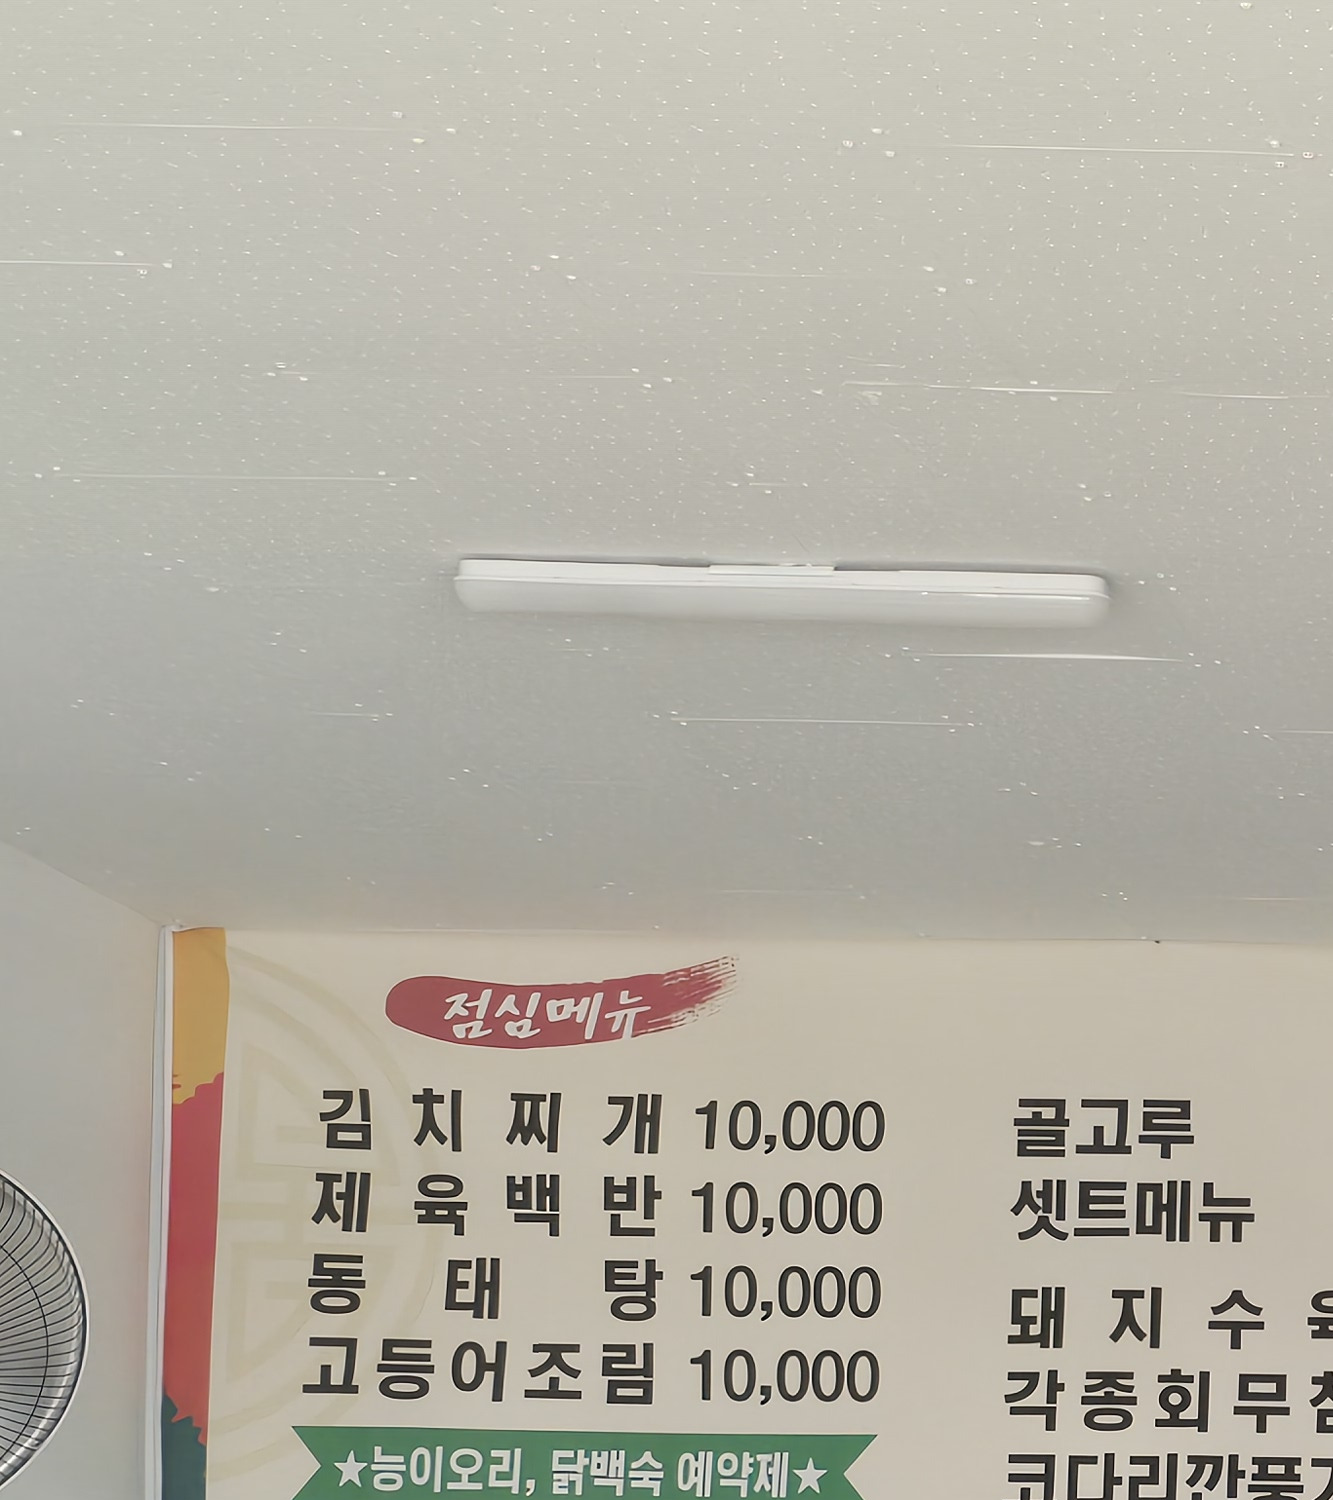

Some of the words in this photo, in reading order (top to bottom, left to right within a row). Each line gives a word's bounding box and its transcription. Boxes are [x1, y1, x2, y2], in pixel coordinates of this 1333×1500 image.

[442, 987, 653, 1042] 점심메뉴
[695, 1100, 886, 1155] 10,000
[1013, 1098, 1195, 1160] 골고루
[691, 1181, 883, 1238] 10,000
[1009, 1178, 1255, 1243] 셋트메뉴
[690, 1265, 882, 1322] 10,000
[302, 1336, 654, 1405] 고등어조림
[689, 1349, 880, 1406] 10,000
[551, 1449, 664, 1497] 닭백숙
[677, 1450, 789, 1498] 예약제
